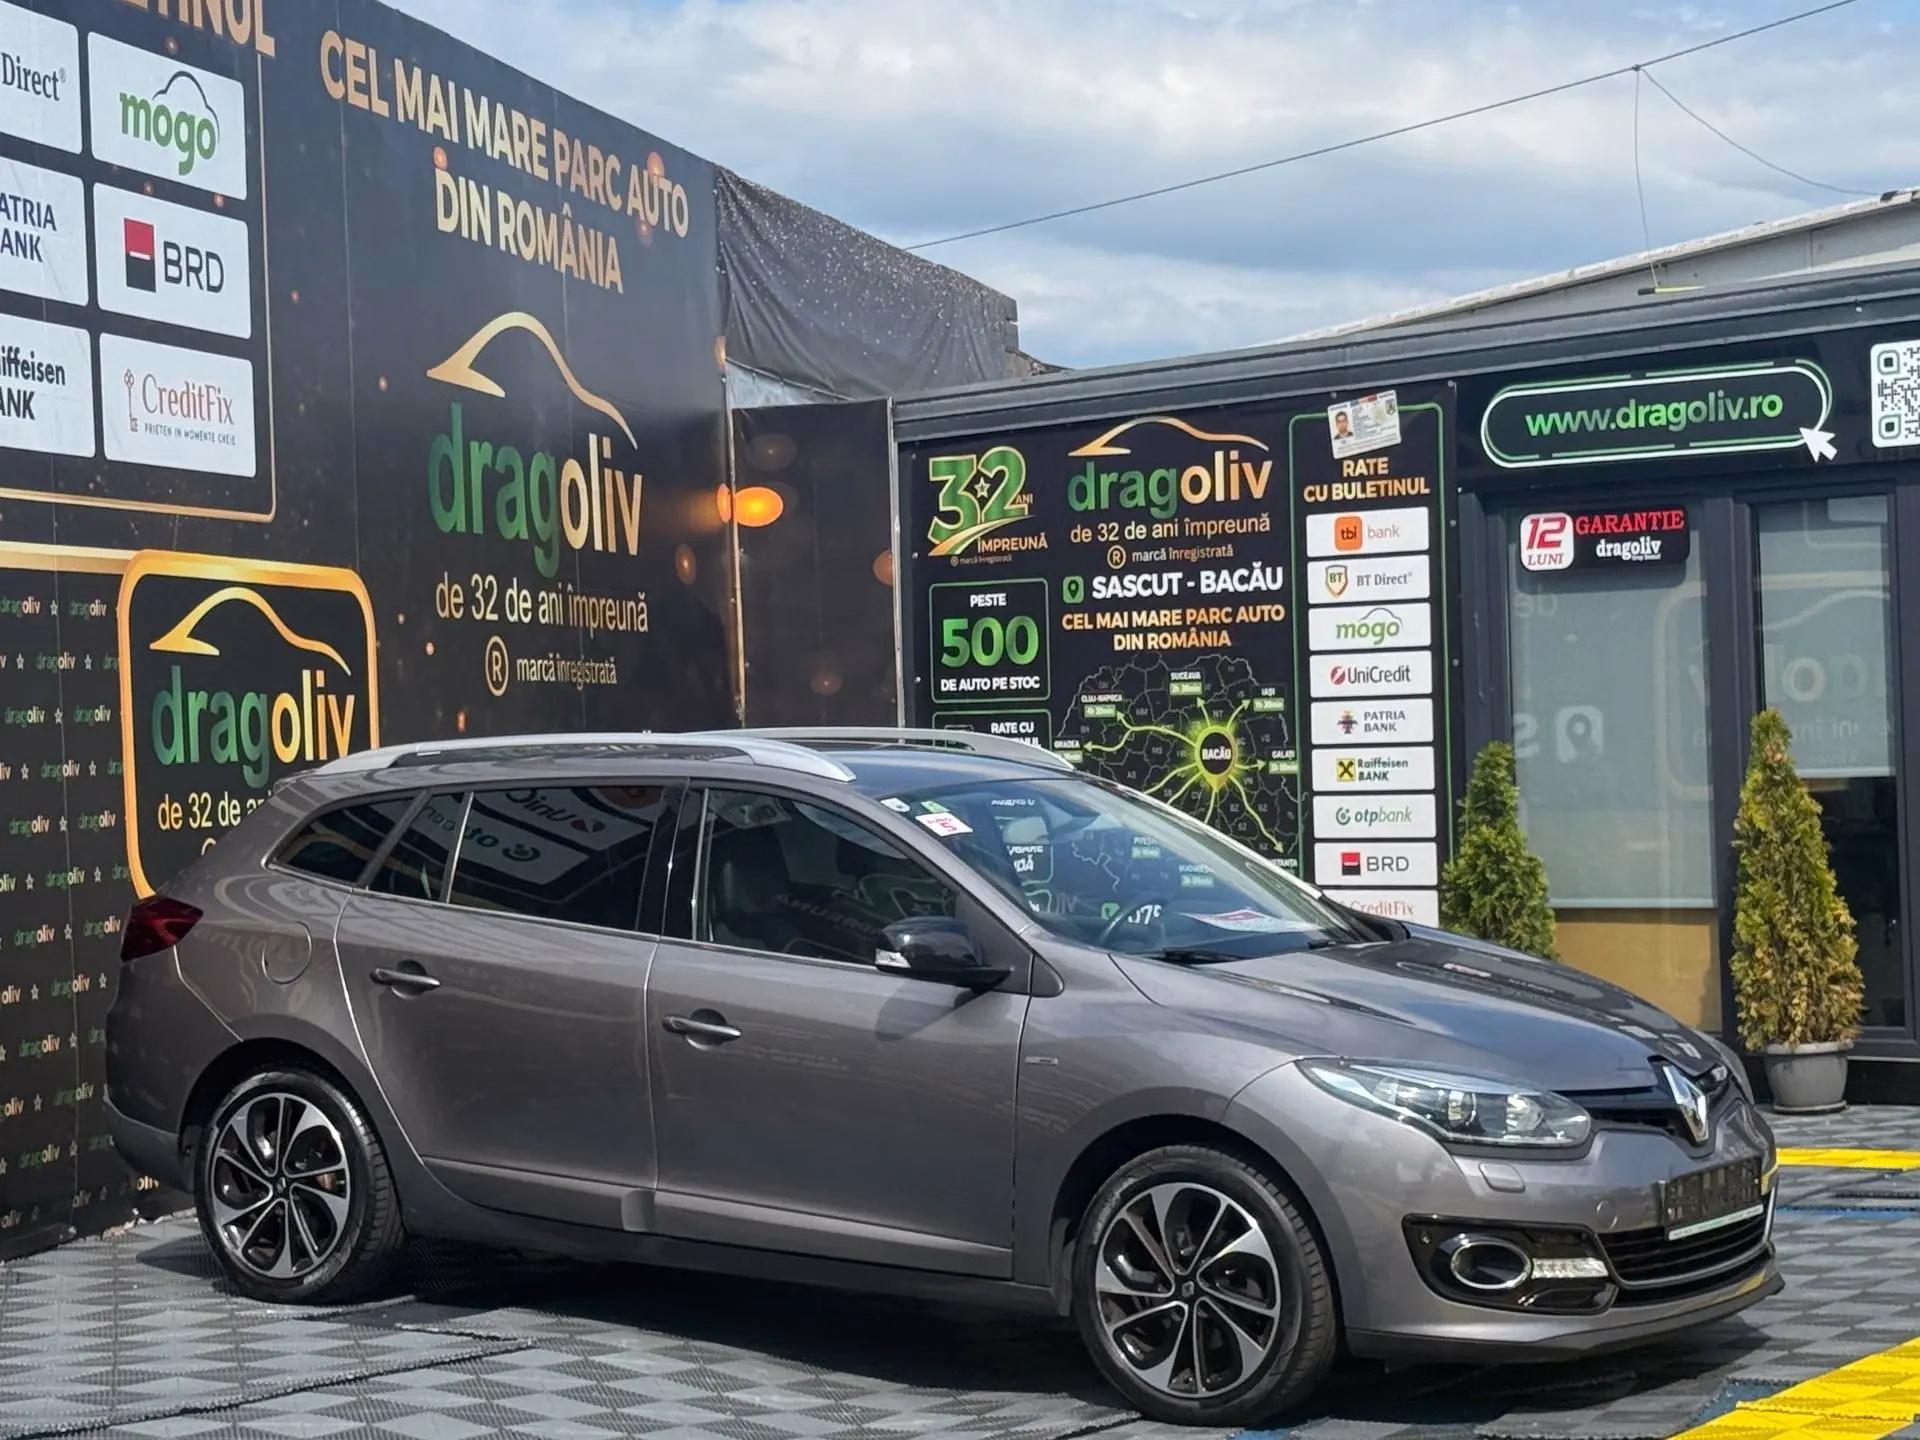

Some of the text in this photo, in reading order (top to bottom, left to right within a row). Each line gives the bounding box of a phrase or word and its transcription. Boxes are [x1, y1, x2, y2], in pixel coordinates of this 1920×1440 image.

[119, 92, 217, 175] mogo
[320, 30, 689, 238] CEL MAI MARE PARC AUTO
[435, 169, 624, 293] DIN ROMÂNIA
[163, 240, 225, 293] BRD
[142, 373, 234, 425] CreditFix
[1525, 390, 1783, 437] www.dragoliv.ro
[1343, 457, 1389, 477] RATE
[428, 402, 643, 578] dragoliv
[928, 446, 1026, 545] 32
[1067, 450, 1273, 519] dragoliv
[1303, 477, 1431, 503] CU BULETINUL
[1070, 512, 1271, 543] de 32 de ani împreună
[1341, 525, 1400, 540] tbi bank
[1526, 510, 1684, 549] 12 GARANTIE
[1132, 548, 1166, 562] marcă
[1168, 544, 1234, 562] înregistrată
[1528, 553, 1564, 566] LUNI
[1596, 536, 1662, 560] dragoliv
[1092, 572, 1184, 599] SASCUT
[1200, 561, 1284, 594] BACĂU
[1356, 574, 1371, 586] BT
[436, 571, 649, 639] de 32 de ani împreună
[970, 593, 1007, 607] PESTE
[1062, 604, 1286, 630] CEL MAI MARE PARC AUTO
[940, 615, 1039, 668] 500
[1113, 628, 1232, 651] DIN ROMÂNIA
[1336, 622, 1401, 646] mogo
[516, 653, 557, 683] marcă
[557, 654, 617, 691] înregistrată
[940, 676, 1041, 692] DE AUTO PE STOC
[1347, 665, 1411, 684] UniCredit
[153, 665, 355, 788] dragoliv
[991, 721, 1034, 734] RATE CU
[1364, 711, 1406, 721] PATRIA
[1364, 722, 1397, 733] BANK
[1357, 757, 1409, 769] Raiffeisen
[1358, 771, 1389, 781] BANK
[158, 793, 183, 830] de
[188, 792, 213, 828] 32
[218, 791, 242, 827] de
[1354, 806, 1412, 827] otpbank
[1366, 856, 1410, 872] BRD
